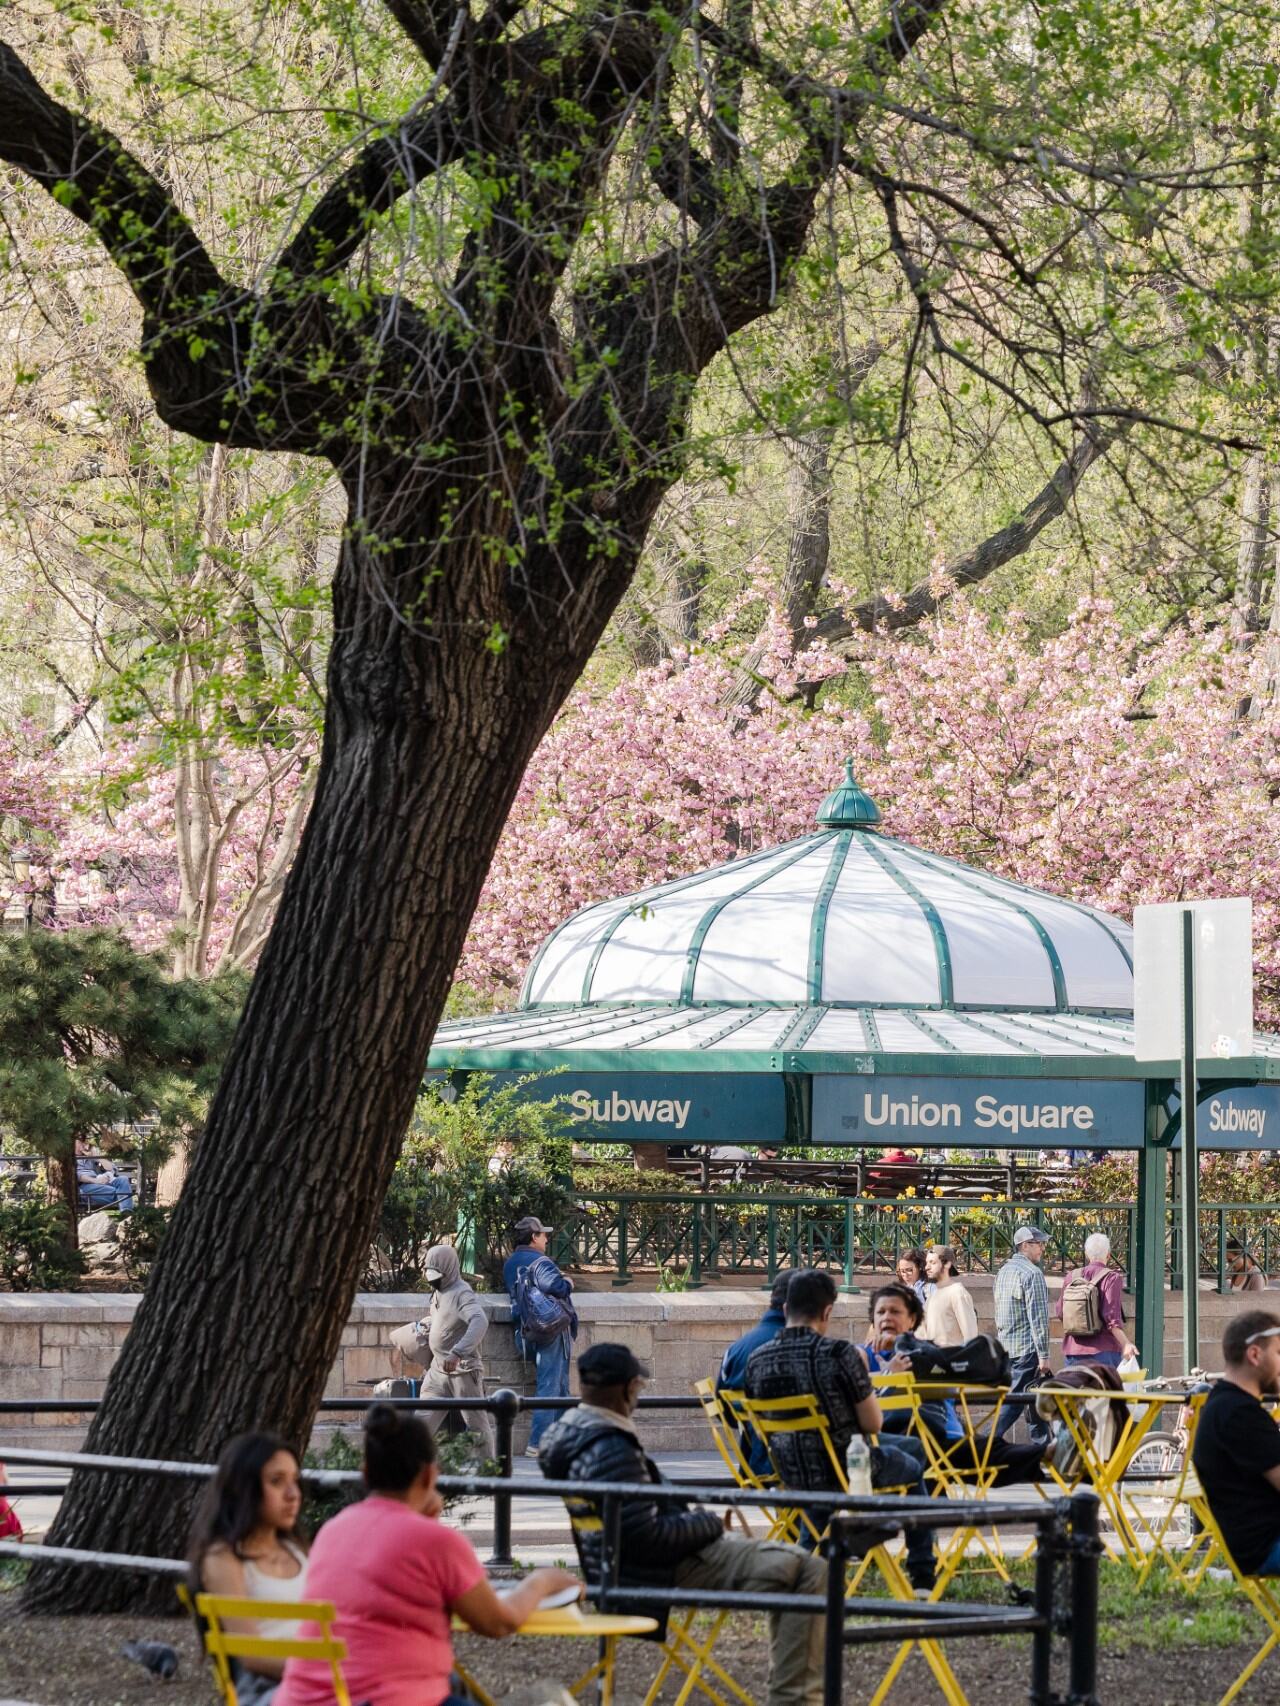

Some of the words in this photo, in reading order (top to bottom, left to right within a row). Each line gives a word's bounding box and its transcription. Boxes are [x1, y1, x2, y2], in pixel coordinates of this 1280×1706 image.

[571, 1089, 692, 1129] Subway
[864, 1093, 961, 1126] Union
[974, 1095, 1094, 1134] Square
[1209, 1099, 1266, 1138] Subway
